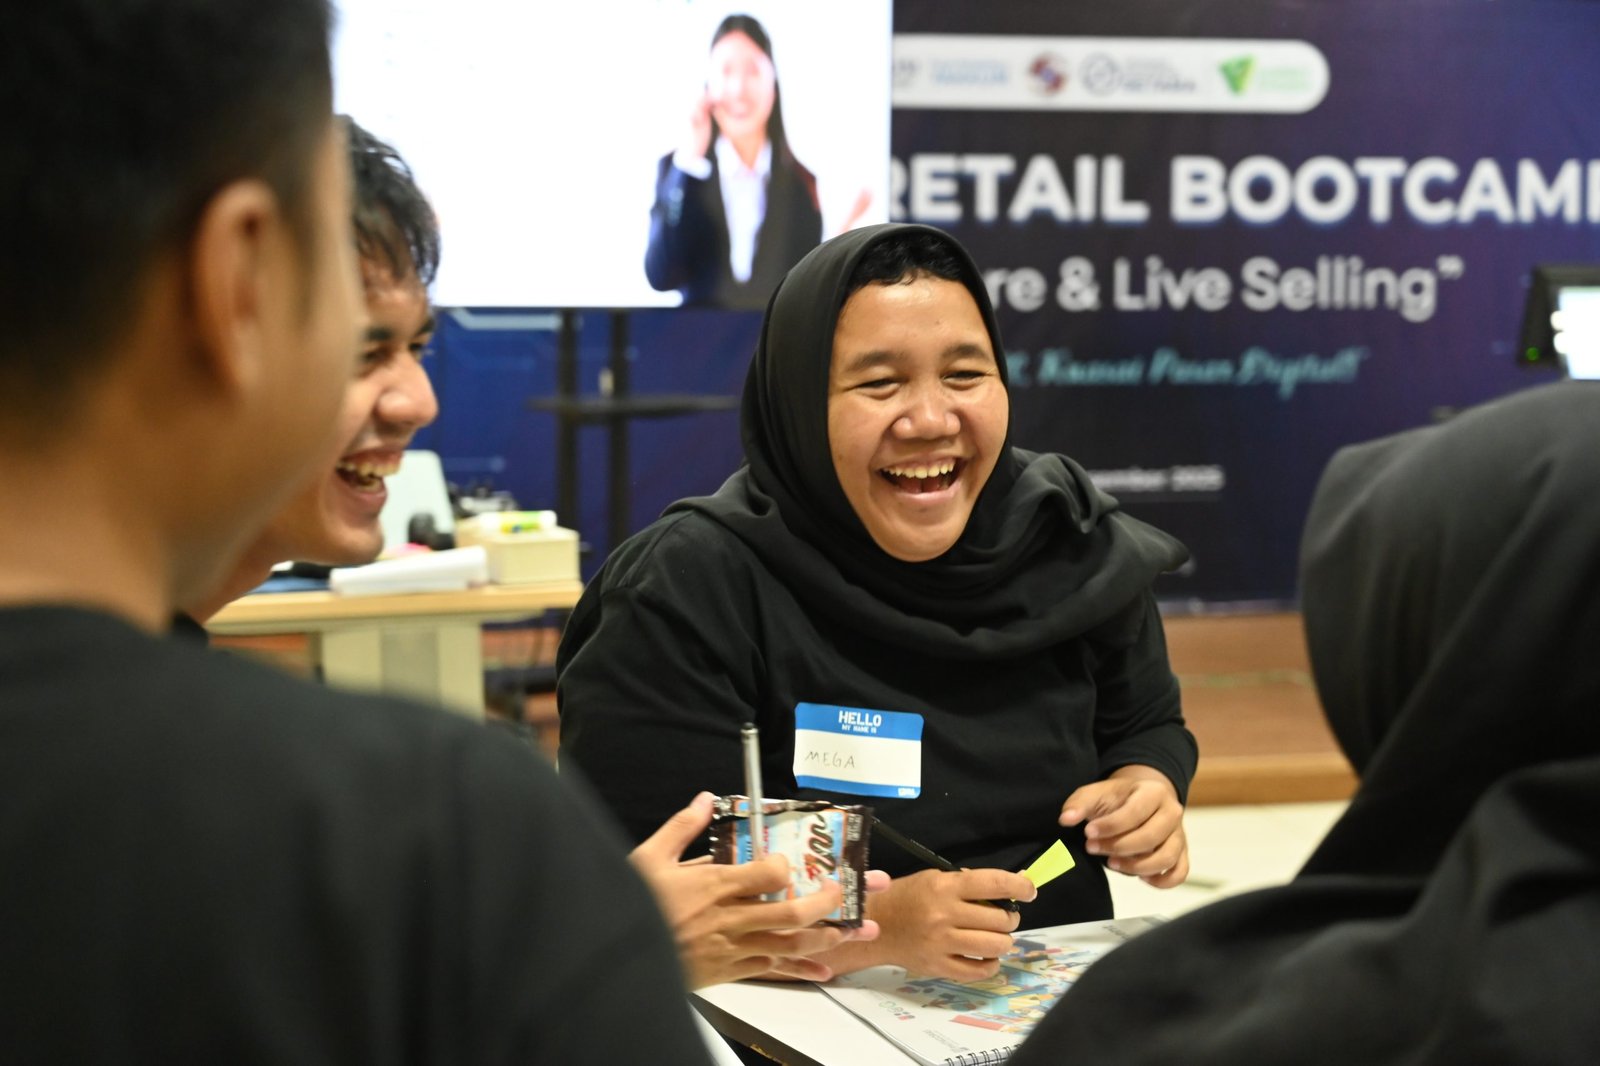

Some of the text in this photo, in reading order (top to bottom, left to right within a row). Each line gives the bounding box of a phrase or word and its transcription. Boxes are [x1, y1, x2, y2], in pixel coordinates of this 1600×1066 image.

[984, 266, 1047, 313] re
[1056, 255, 1100, 313] &
[1113, 254, 1232, 312] Live
[838, 710, 882, 727] HELLO
[805, 751, 855, 769] MEGA
